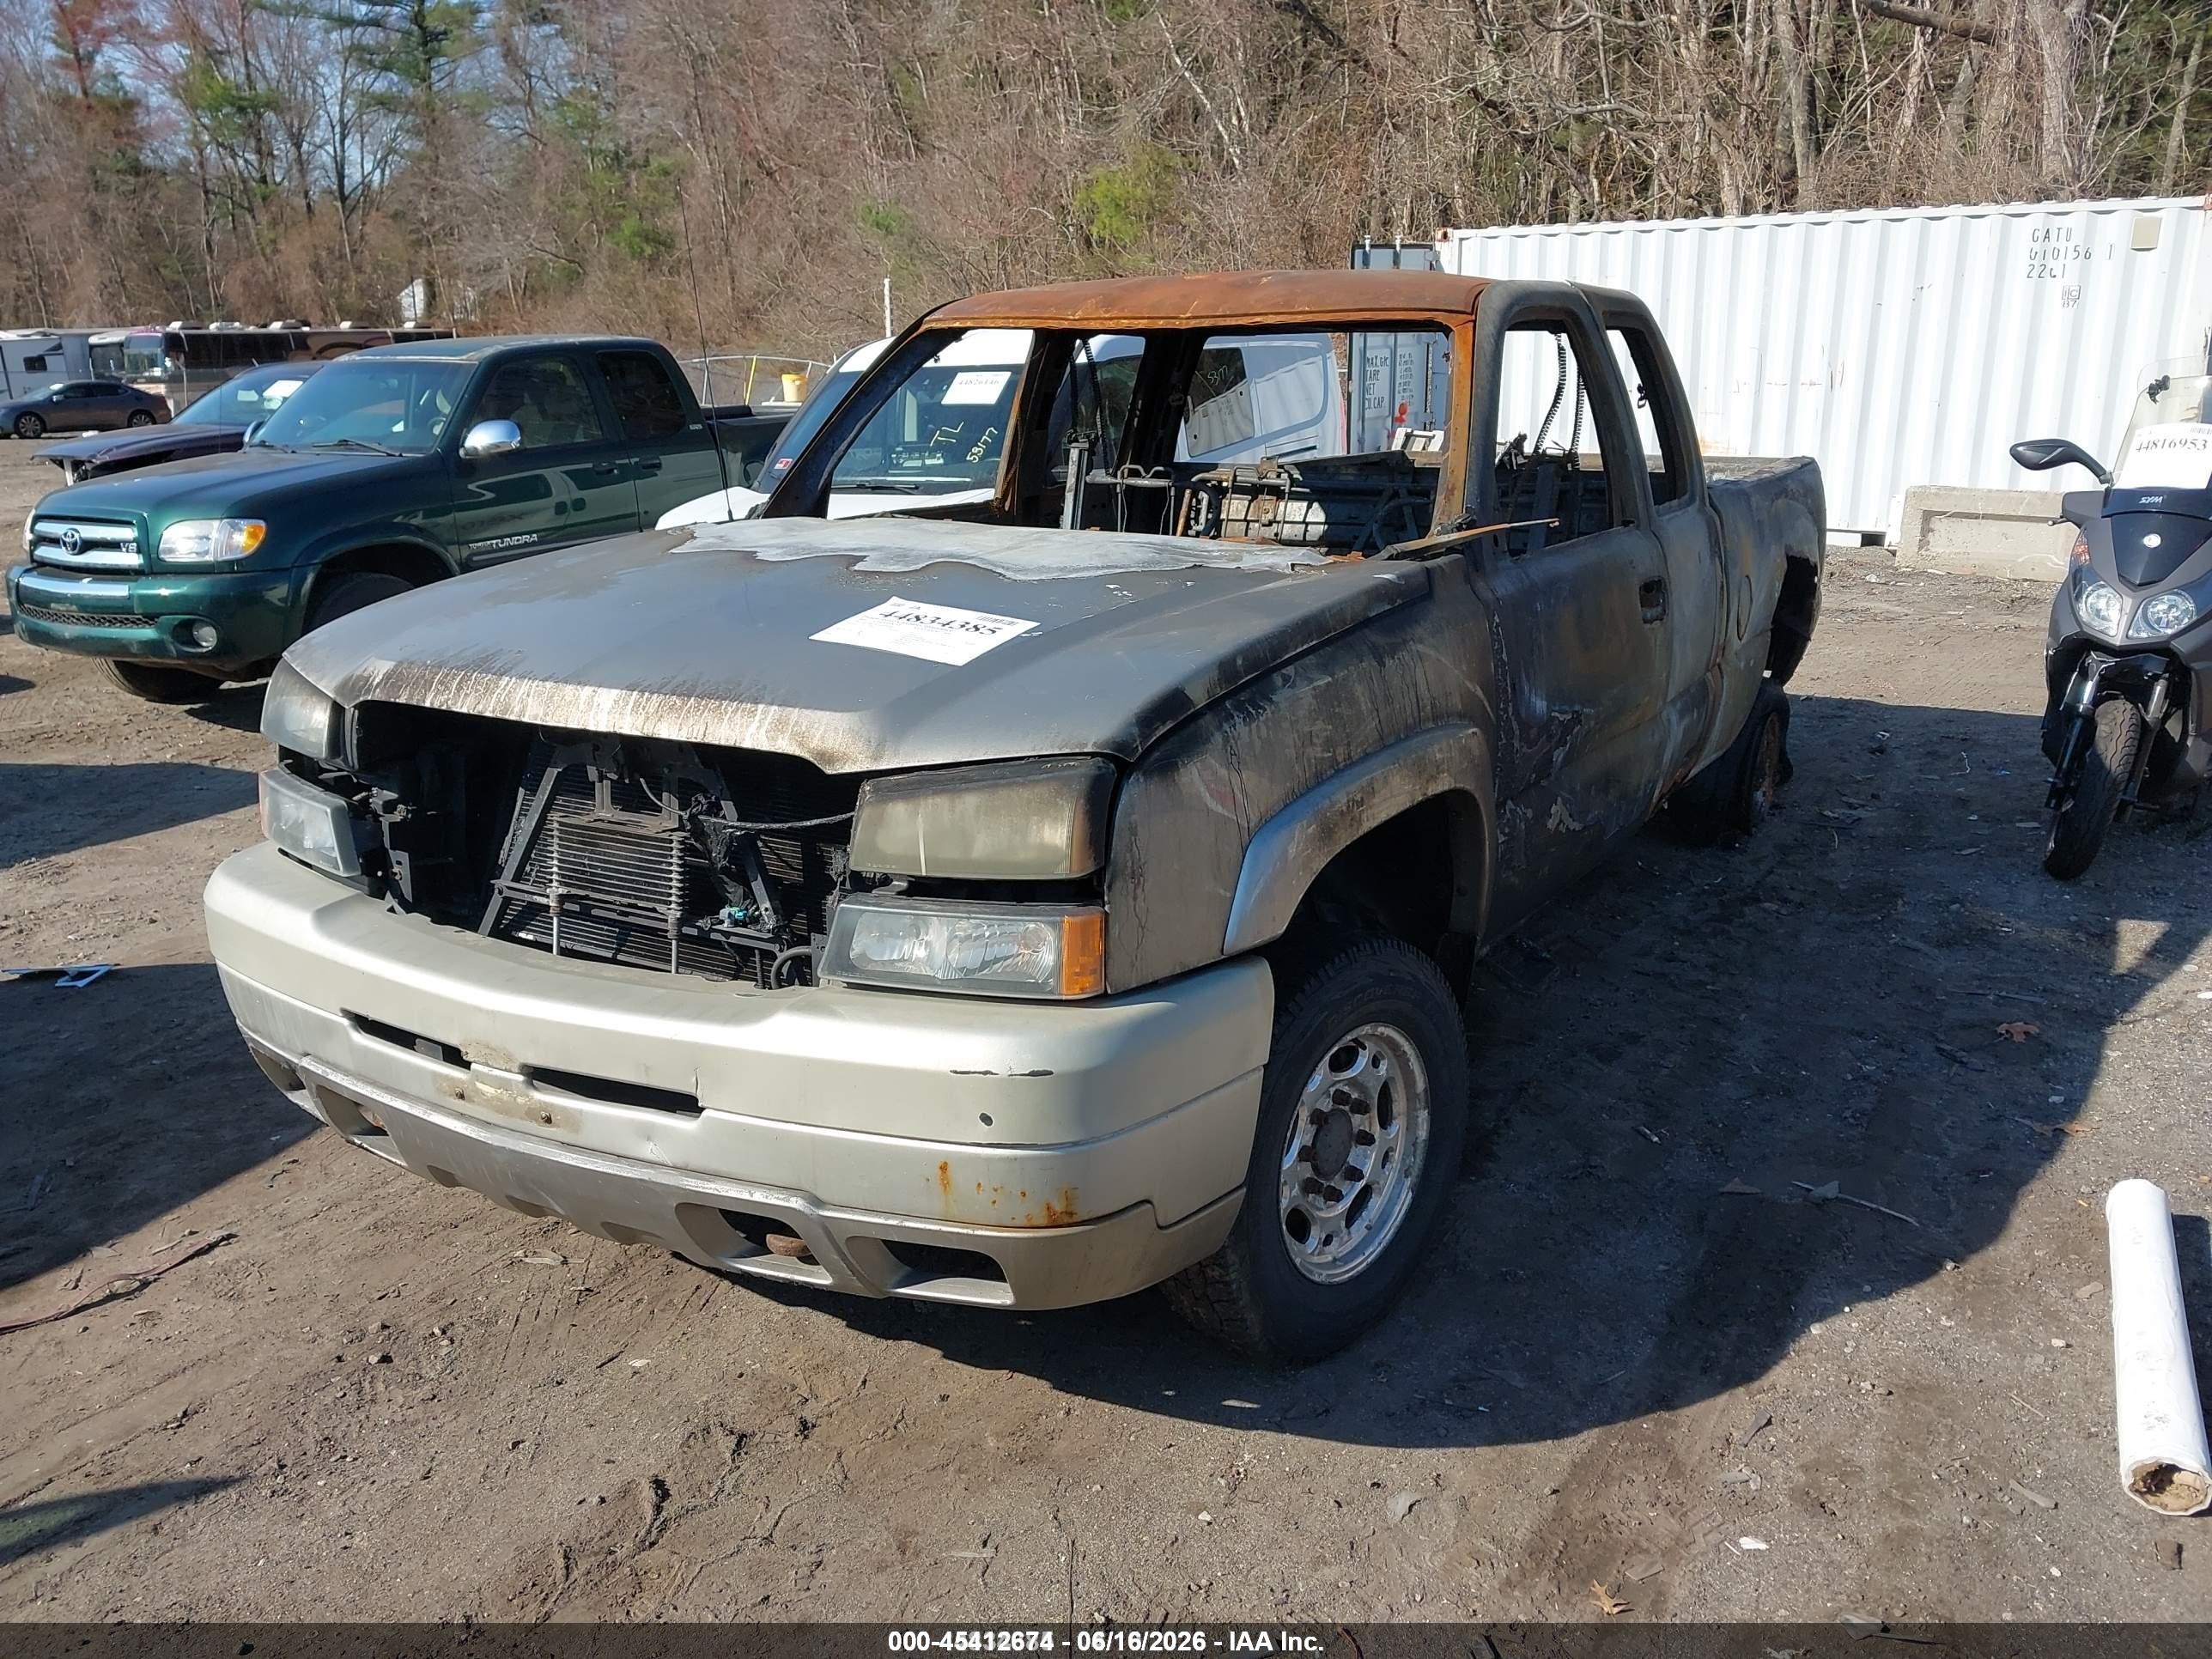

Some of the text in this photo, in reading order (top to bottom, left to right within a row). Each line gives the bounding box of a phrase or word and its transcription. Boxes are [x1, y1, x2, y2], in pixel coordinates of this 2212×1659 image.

[2032, 227, 2072, 243] GATU
[2136, 438, 2208, 453] 44816953
[2138, 495, 2163, 504] SYM
[120, 542, 137, 553] V8
[492, 533, 538, 550] TUNDRA
[878, 610, 1006, 635] 44834385
